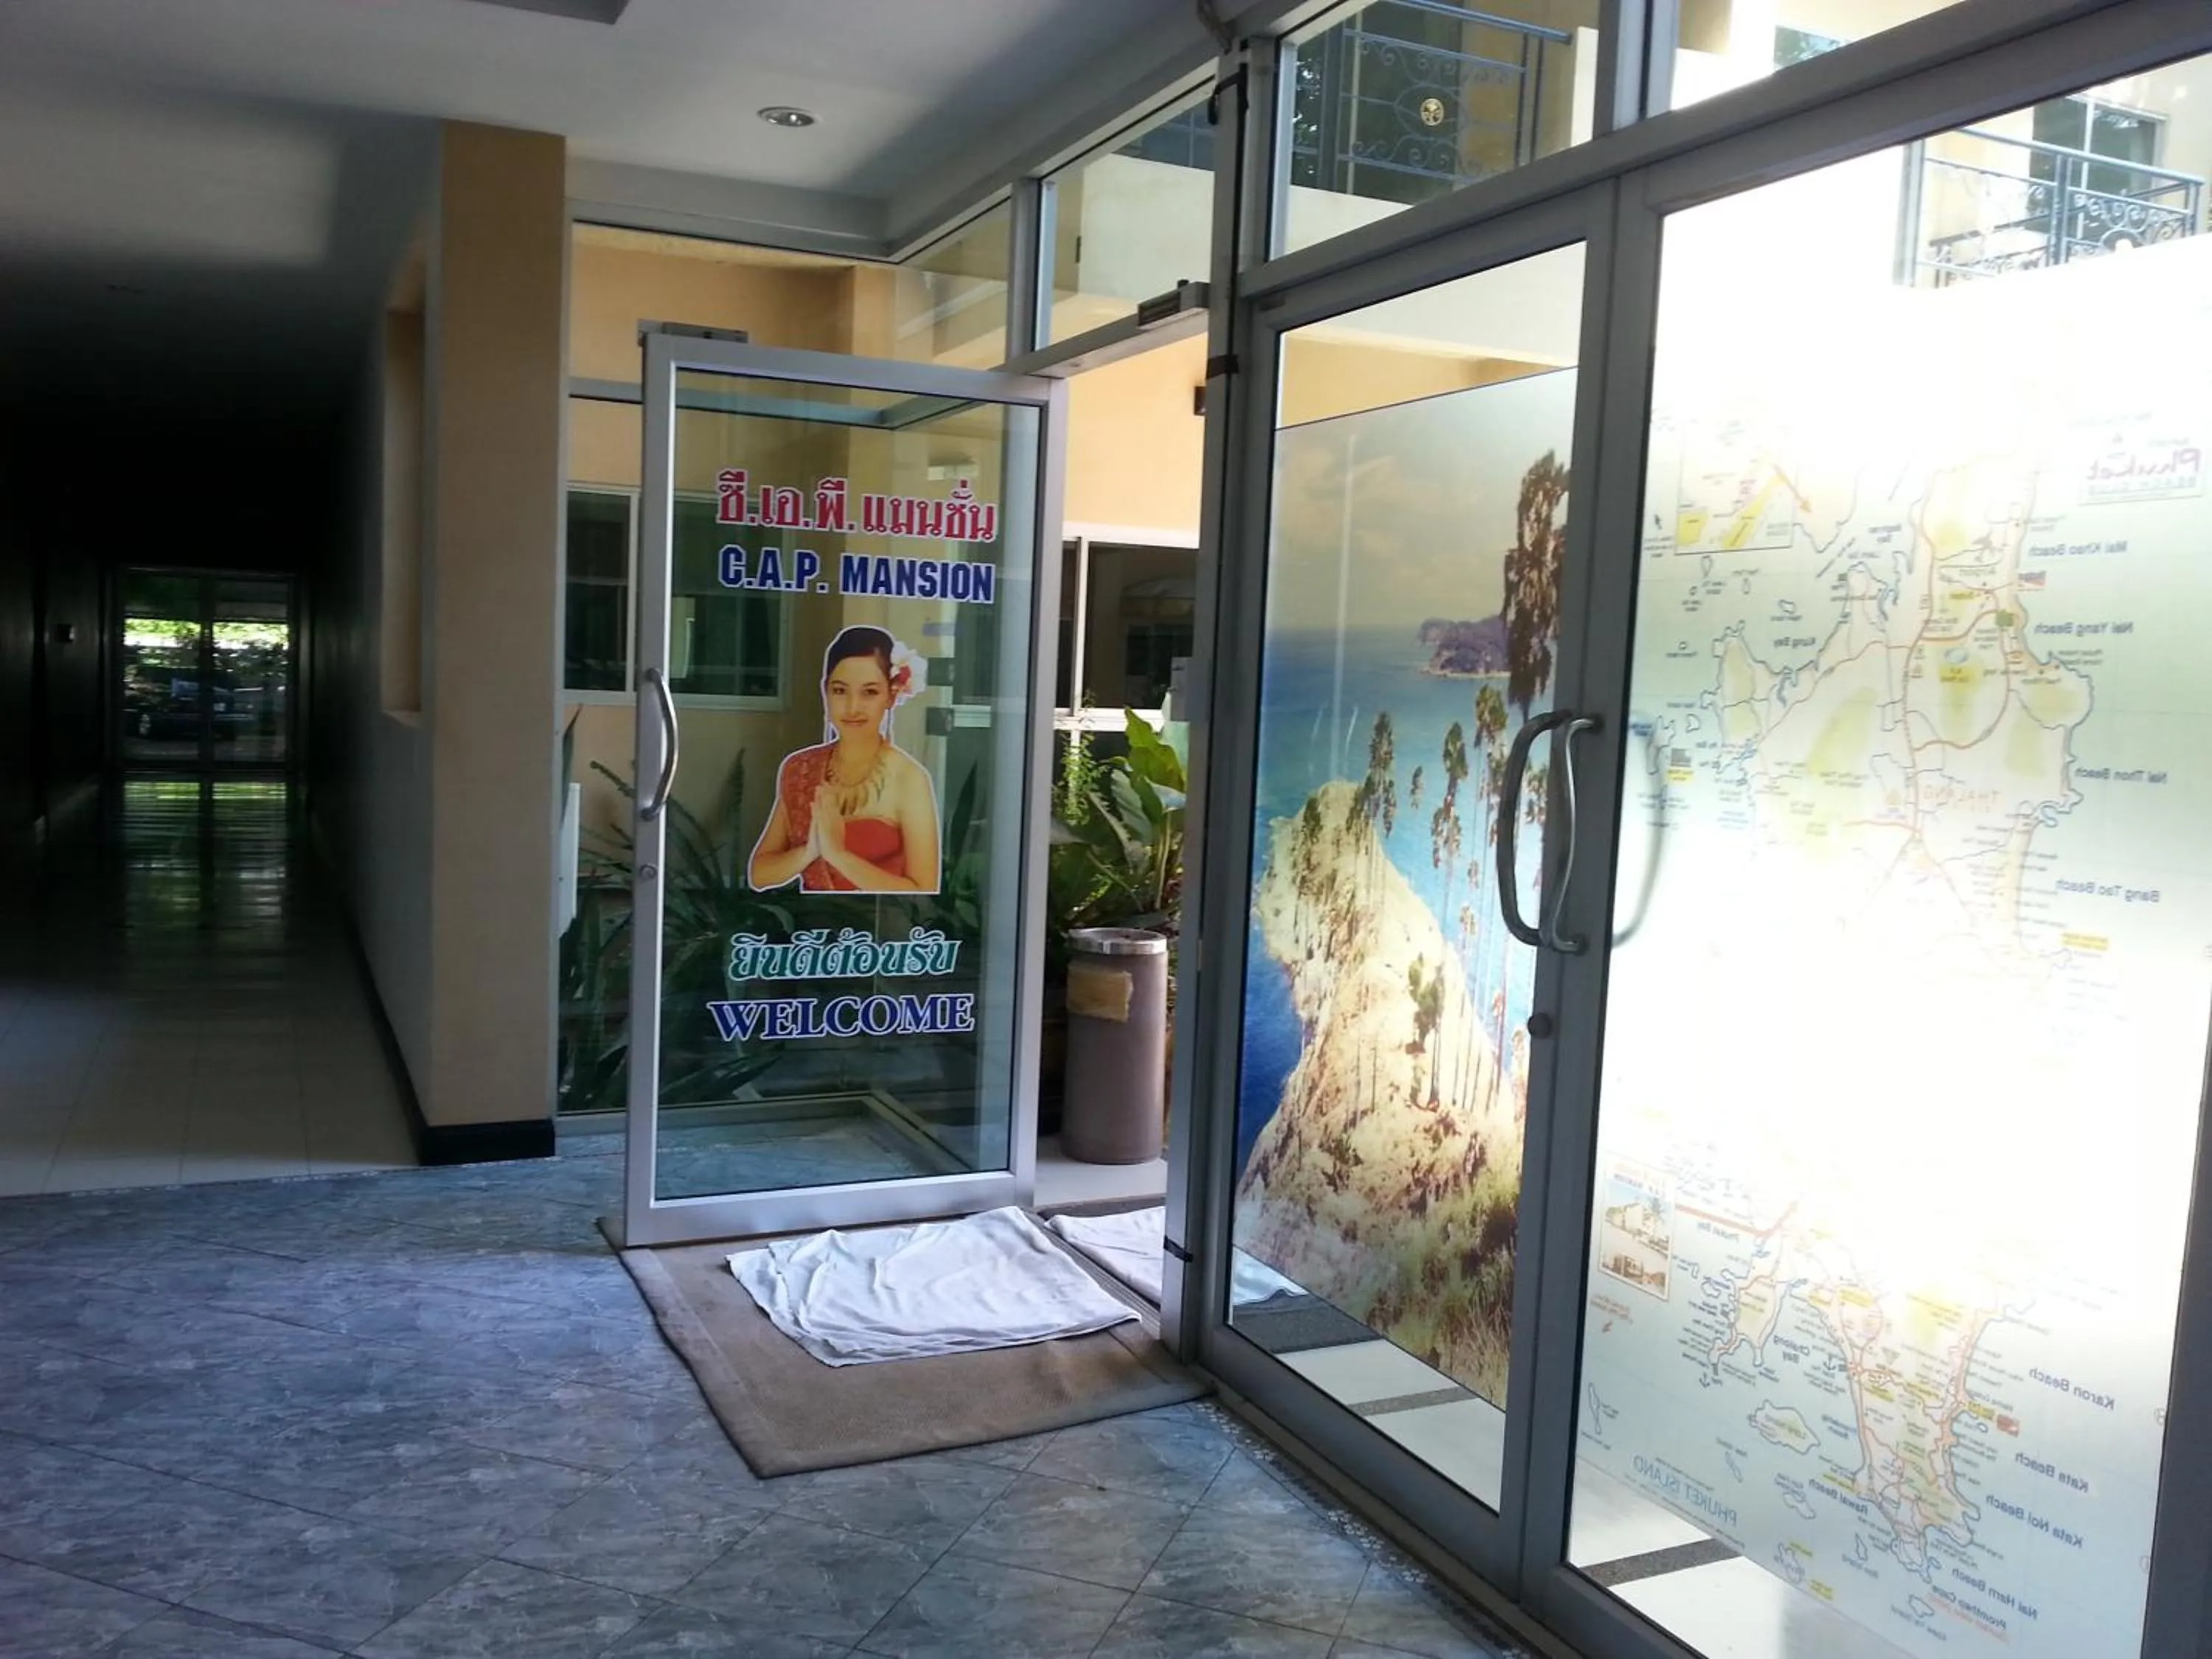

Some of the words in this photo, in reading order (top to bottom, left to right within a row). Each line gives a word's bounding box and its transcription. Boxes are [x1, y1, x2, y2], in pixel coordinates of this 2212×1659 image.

[719, 544, 830, 593] C.A.P.
[839, 553, 996, 603] MANSION
[728, 926, 961, 981] ยินดีต้อนรับ
[706, 994, 975, 1042] WELCOME
